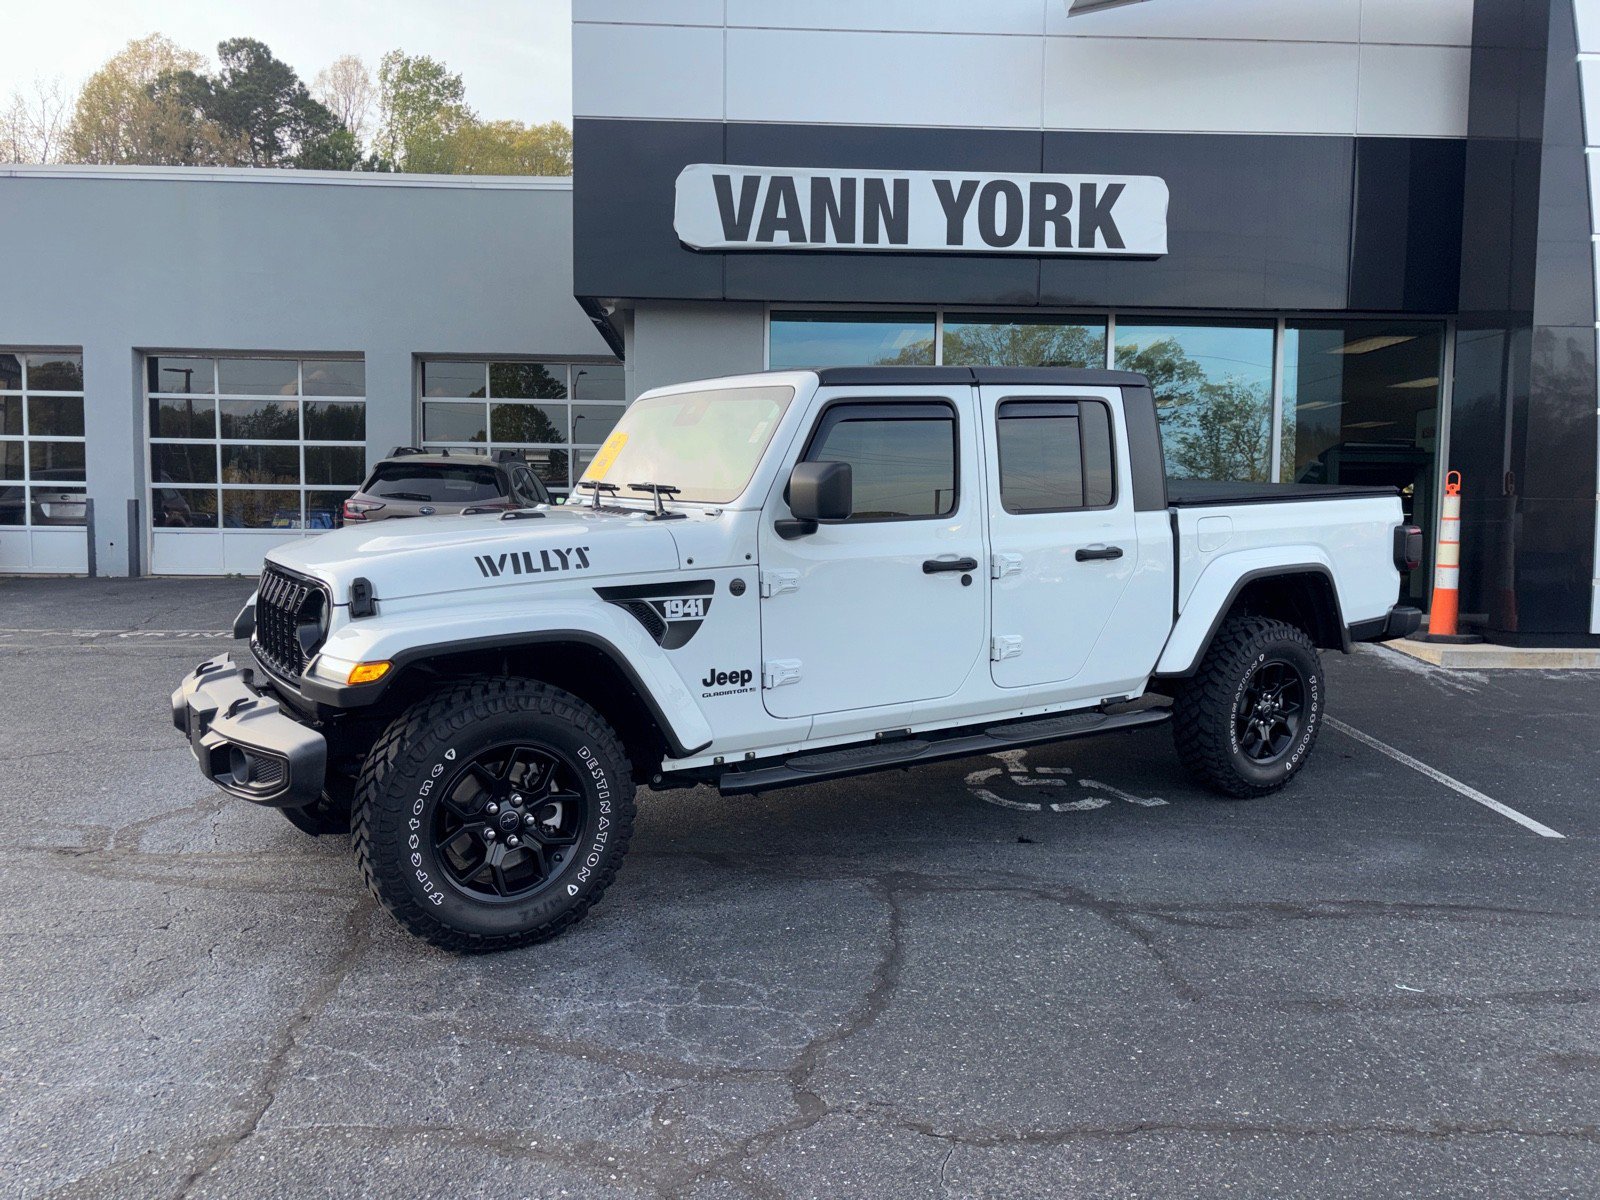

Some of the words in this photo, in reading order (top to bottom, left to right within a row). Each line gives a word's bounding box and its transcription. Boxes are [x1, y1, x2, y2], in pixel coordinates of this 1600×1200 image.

[713, 174, 909, 246] VANN
[932, 179, 1126, 249] YORK
[474, 546, 590, 577] WILLYS
[663, 598, 705, 618] 1941
[702, 668, 753, 687] Jeep
[702, 688, 748, 698] GLADIATOR
[577, 746, 611, 882] DESTINATION
